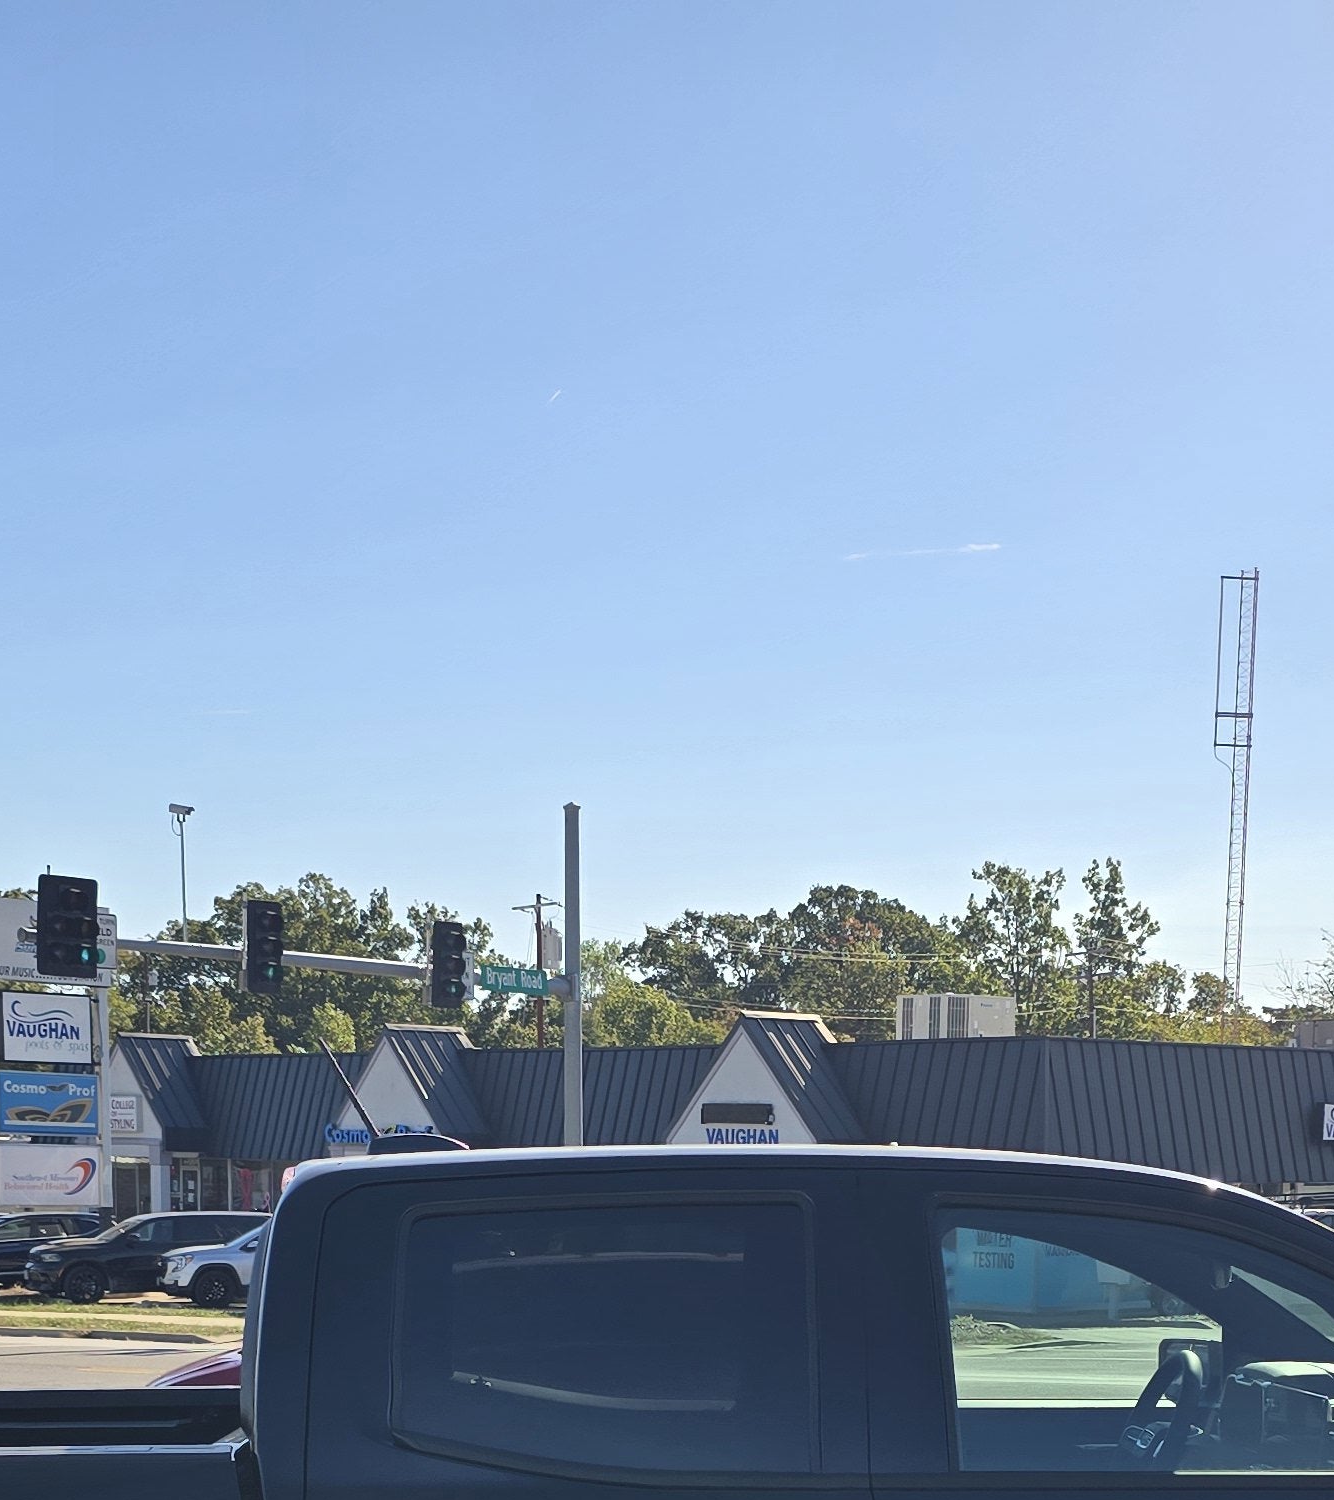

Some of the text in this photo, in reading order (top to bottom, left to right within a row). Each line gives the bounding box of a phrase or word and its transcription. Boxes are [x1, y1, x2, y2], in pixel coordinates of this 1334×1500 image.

[486, 967, 516, 989] Bryant
[521, 970, 543, 990] Road
[6, 1020, 80, 1040] VAUGHAN
[25, 1040, 49, 1052] pools
[69, 1042, 89, 1054] spas
[3, 1080, 96, 1096] Cosmo Prof
[324, 1122, 371, 1144] Cosmo
[706, 1128, 779, 1144] VAUGHAN
[973, 1251, 1015, 1269] TESTING
